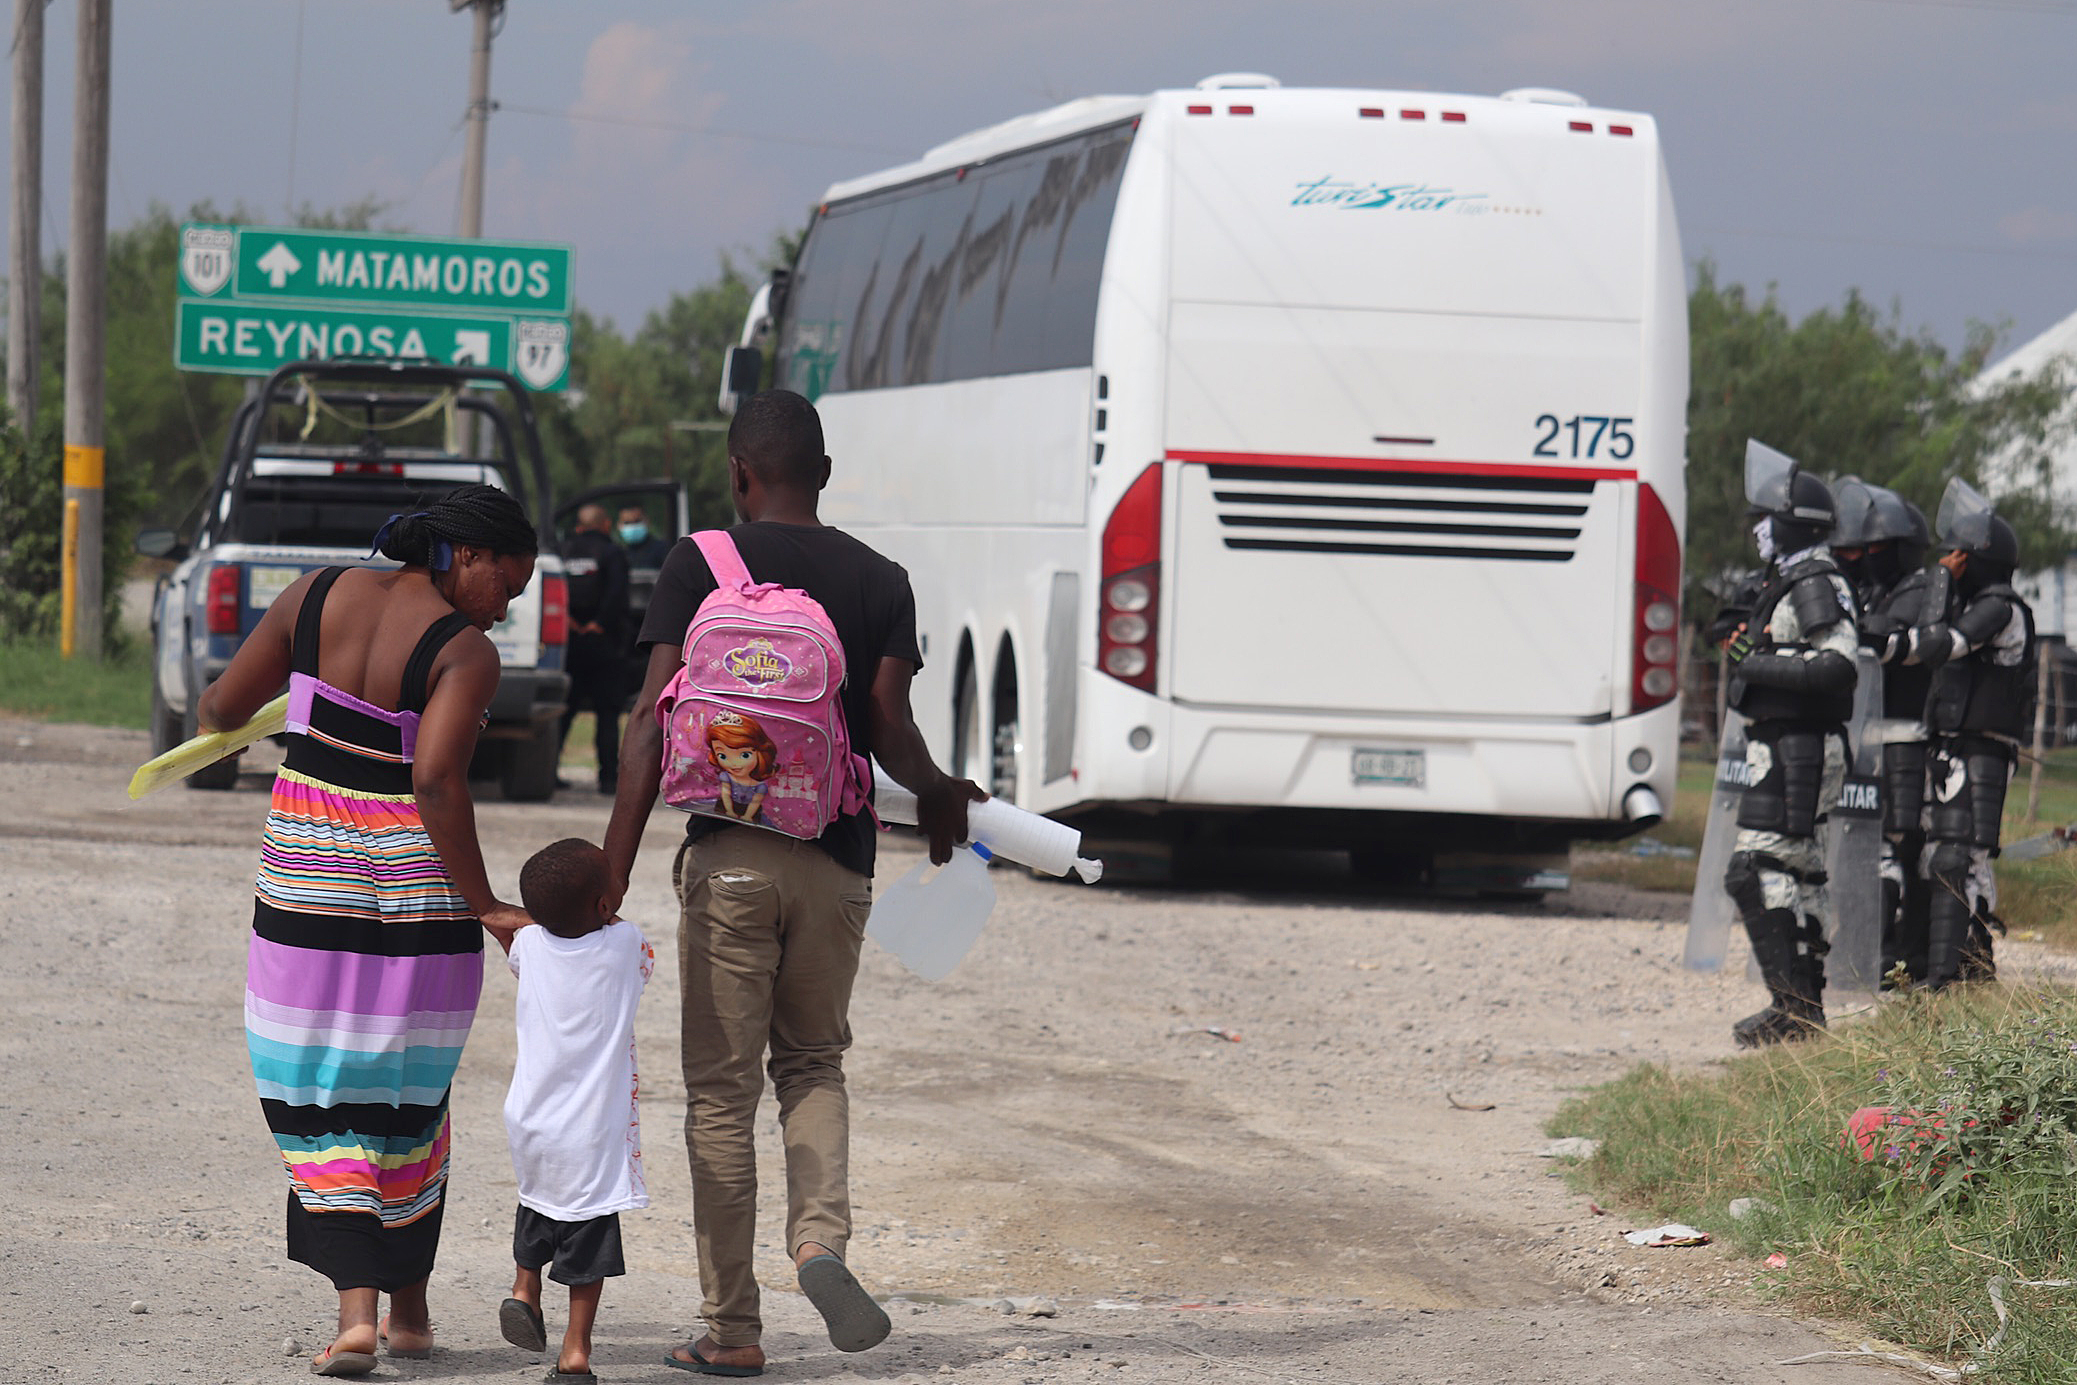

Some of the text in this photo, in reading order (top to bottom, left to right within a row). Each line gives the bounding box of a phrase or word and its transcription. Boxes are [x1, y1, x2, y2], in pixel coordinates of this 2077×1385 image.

[194, 253, 222, 280] 101
[317, 249, 550, 298] MATAMOROS
[200, 317, 427, 360] REYNOSA
[527, 344, 553, 370] 97
[1533, 414, 1634, 460] 2175
[731, 650, 778, 676] Sofia
